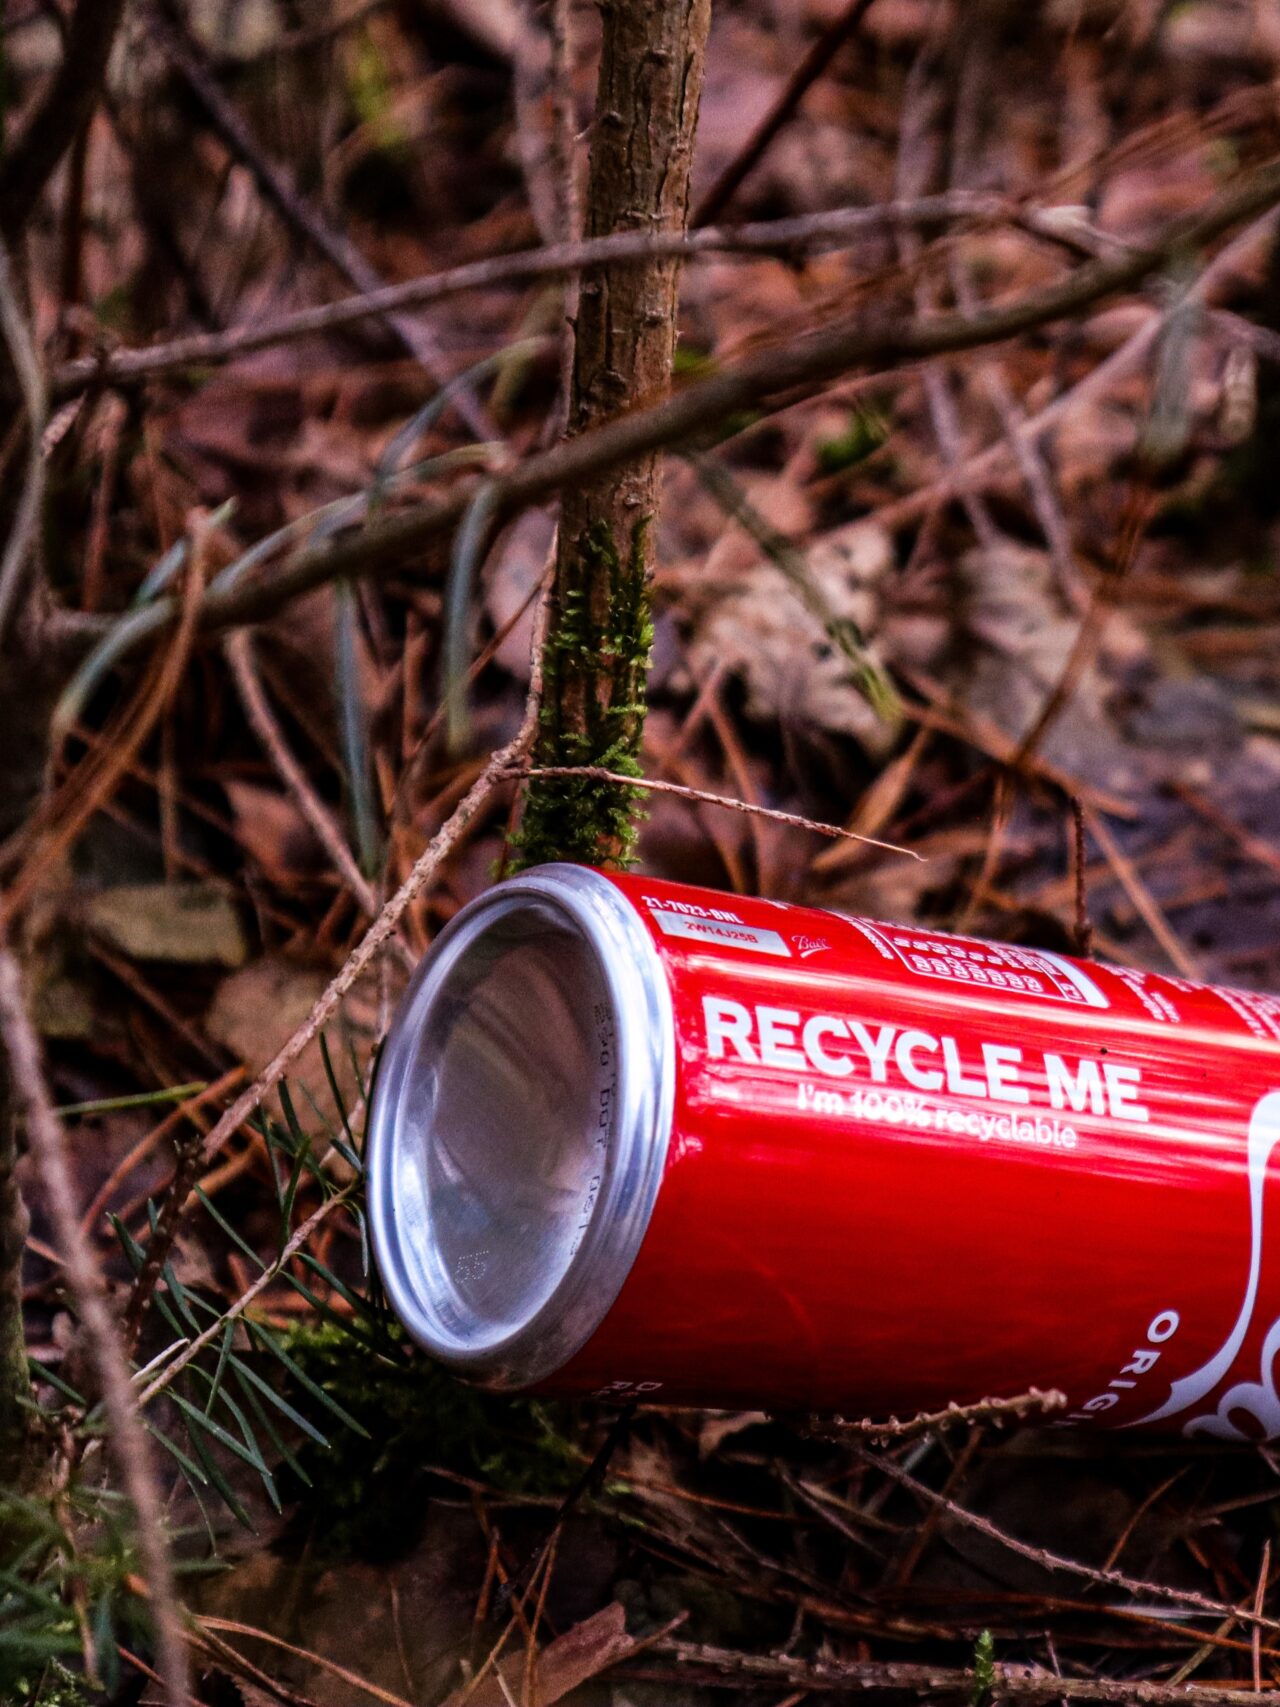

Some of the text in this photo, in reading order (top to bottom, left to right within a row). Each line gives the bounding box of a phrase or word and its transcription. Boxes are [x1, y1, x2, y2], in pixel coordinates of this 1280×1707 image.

[701, 995, 1029, 1104] RECYCLE
[1044, 1053, 1149, 1122] ME
[849, 1089, 931, 1129] 100%
[934, 1107, 1079, 1148] recyclable
